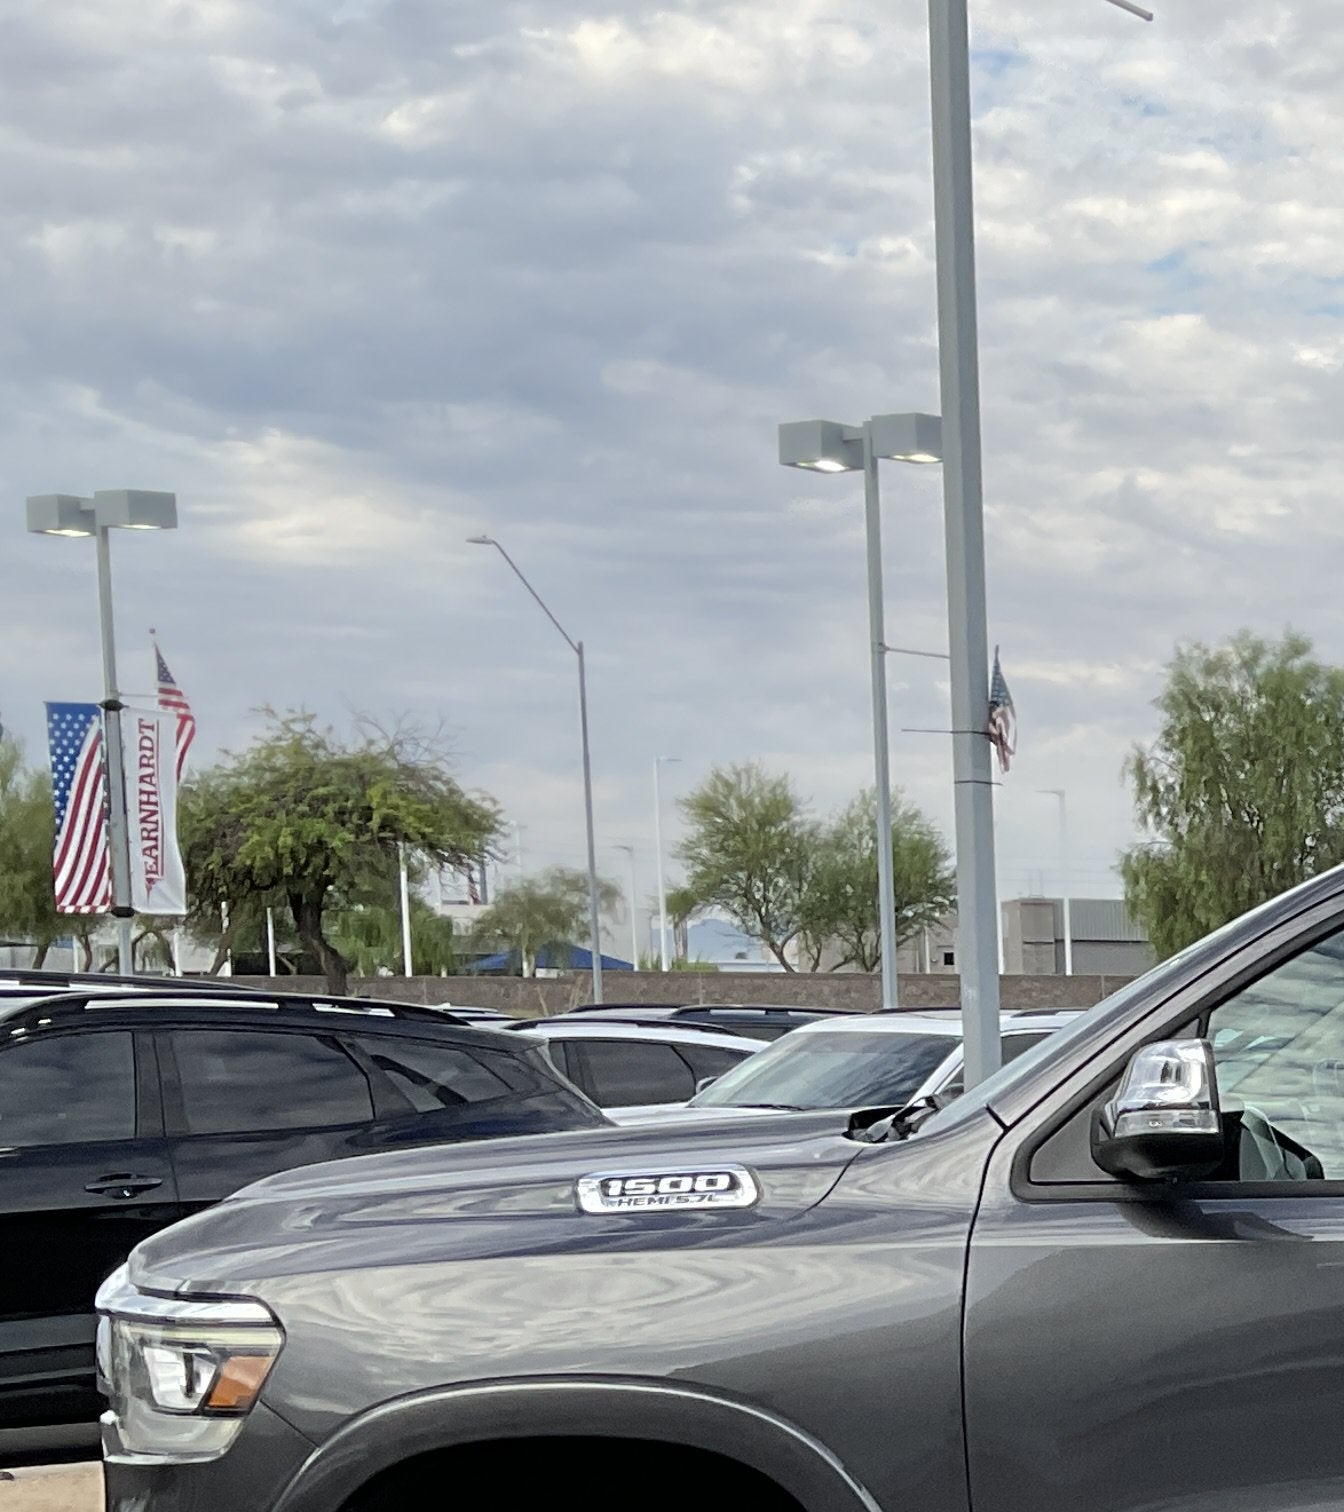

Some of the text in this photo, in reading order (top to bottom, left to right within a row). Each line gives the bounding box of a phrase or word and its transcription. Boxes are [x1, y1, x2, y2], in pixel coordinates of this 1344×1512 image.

[138, 718, 160, 877] EARNHARDT
[606, 1174, 731, 1196] 1500
[617, 1195, 670, 1207] HEMI
